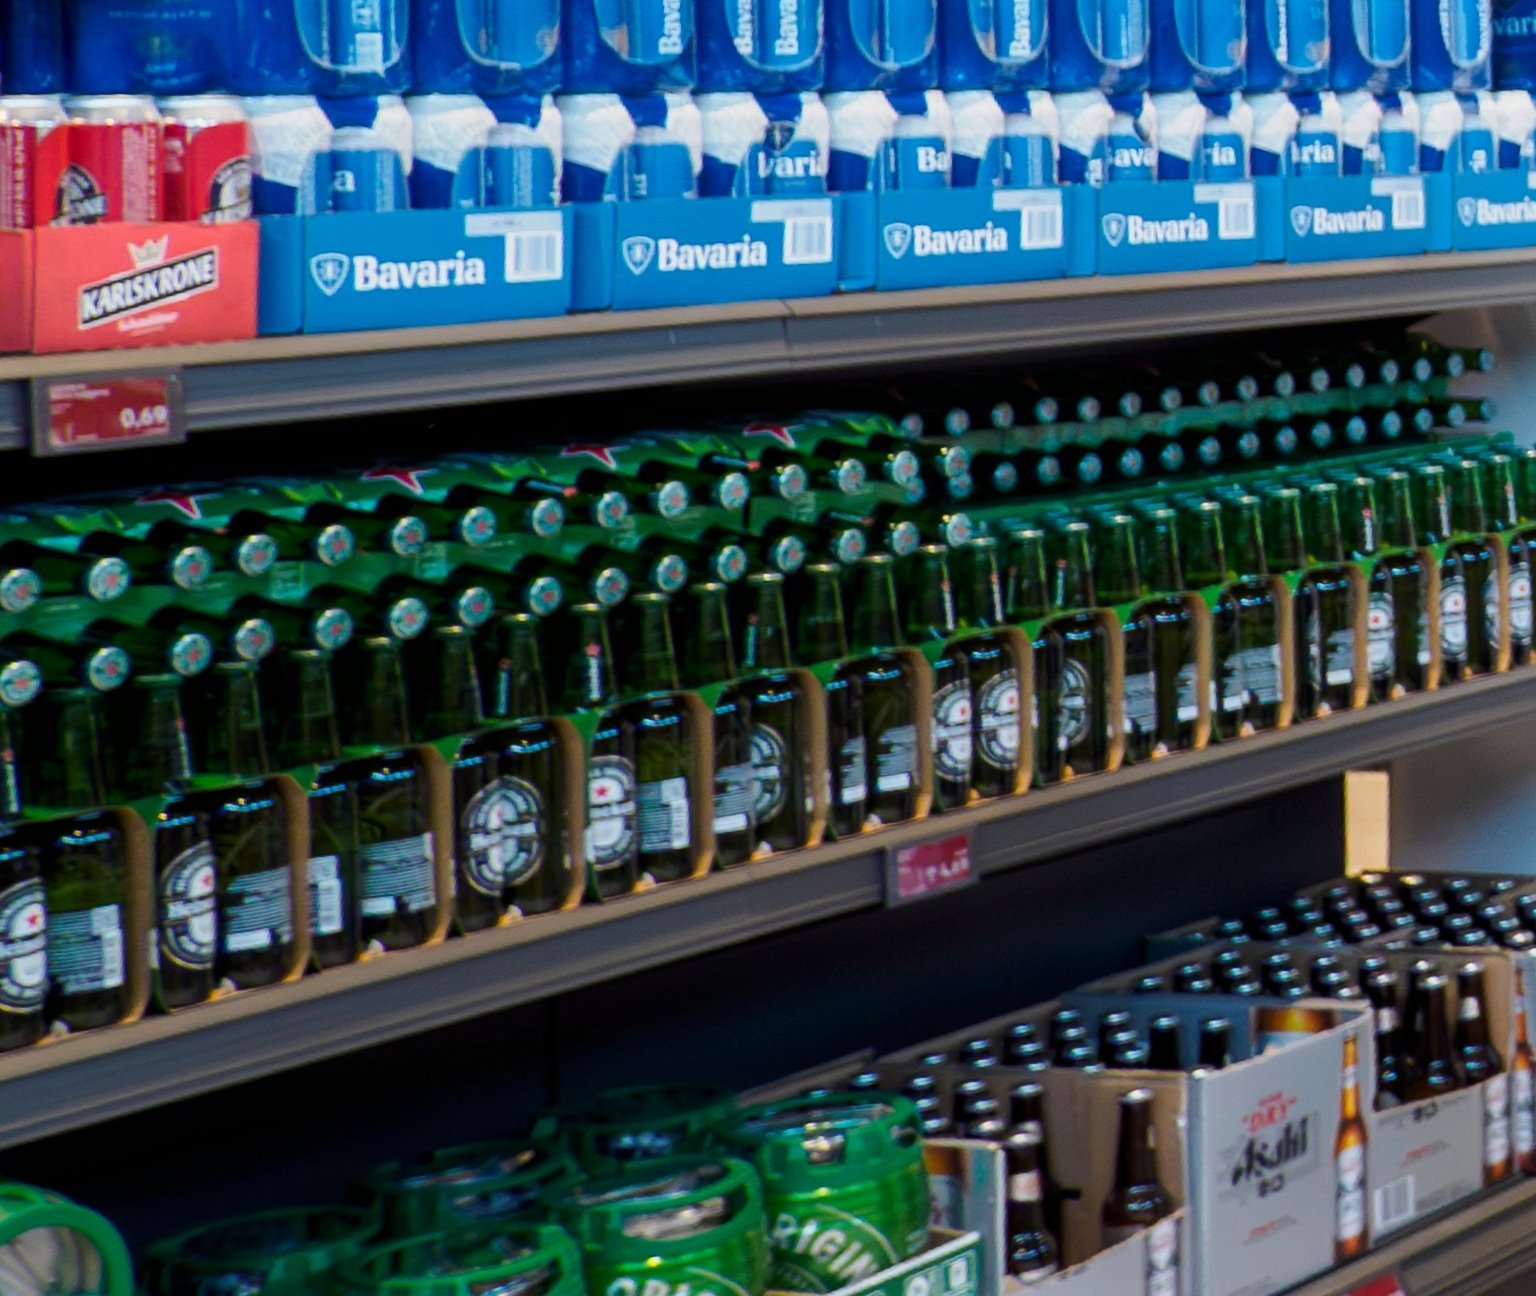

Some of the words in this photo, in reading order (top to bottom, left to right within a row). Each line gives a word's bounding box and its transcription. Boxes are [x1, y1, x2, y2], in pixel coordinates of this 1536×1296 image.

[1127, 212, 1208, 245] Bavaria
[1312, 205, 1384, 235] Bavaria
[658, 234, 767, 272] Bavaria
[913, 221, 1008, 256] Bavaria
[80, 253, 215, 321] KARLSKRONE
[353, 250, 486, 292] Bavaria
